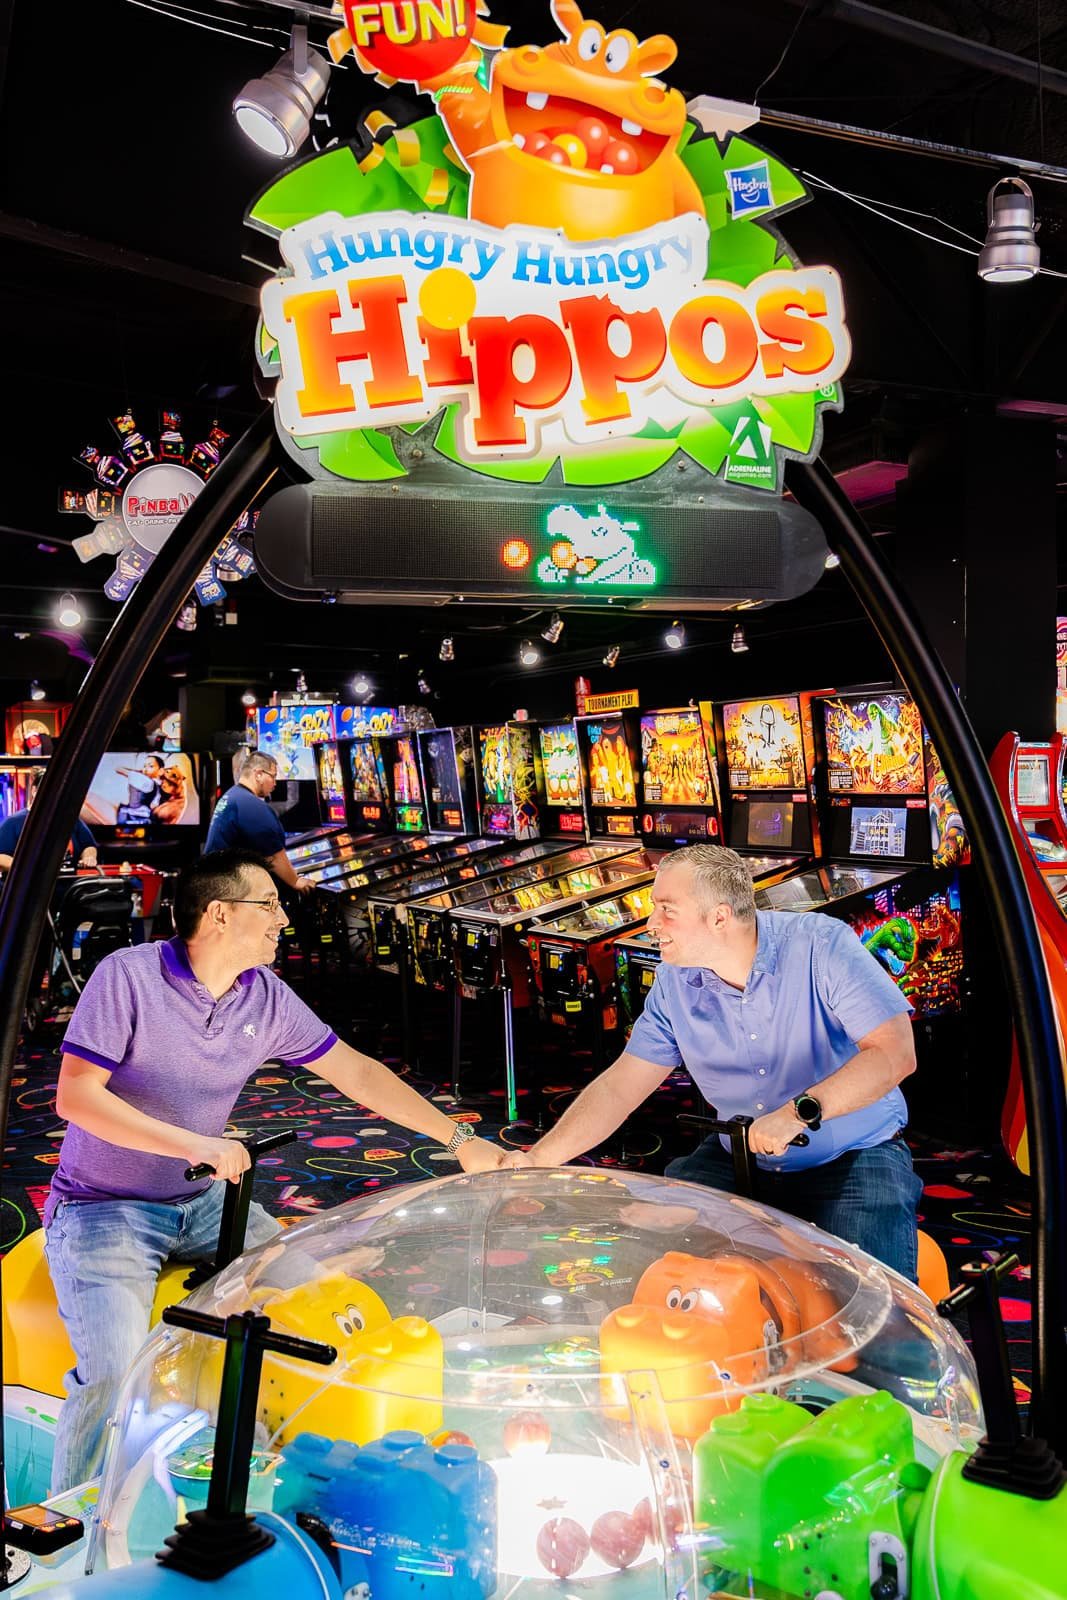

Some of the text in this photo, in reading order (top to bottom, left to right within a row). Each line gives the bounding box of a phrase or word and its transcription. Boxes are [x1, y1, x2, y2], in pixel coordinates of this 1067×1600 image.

[351, 0, 467, 46] FUN!
[732, 177, 769, 192] Hasbro
[303, 226, 695, 290] Hungry Hungry
[282, 267, 836, 447] Hippos
[728, 465, 772, 474] ADRENALINE
[588, 693, 634, 710] TOURNAMENT PLAY
